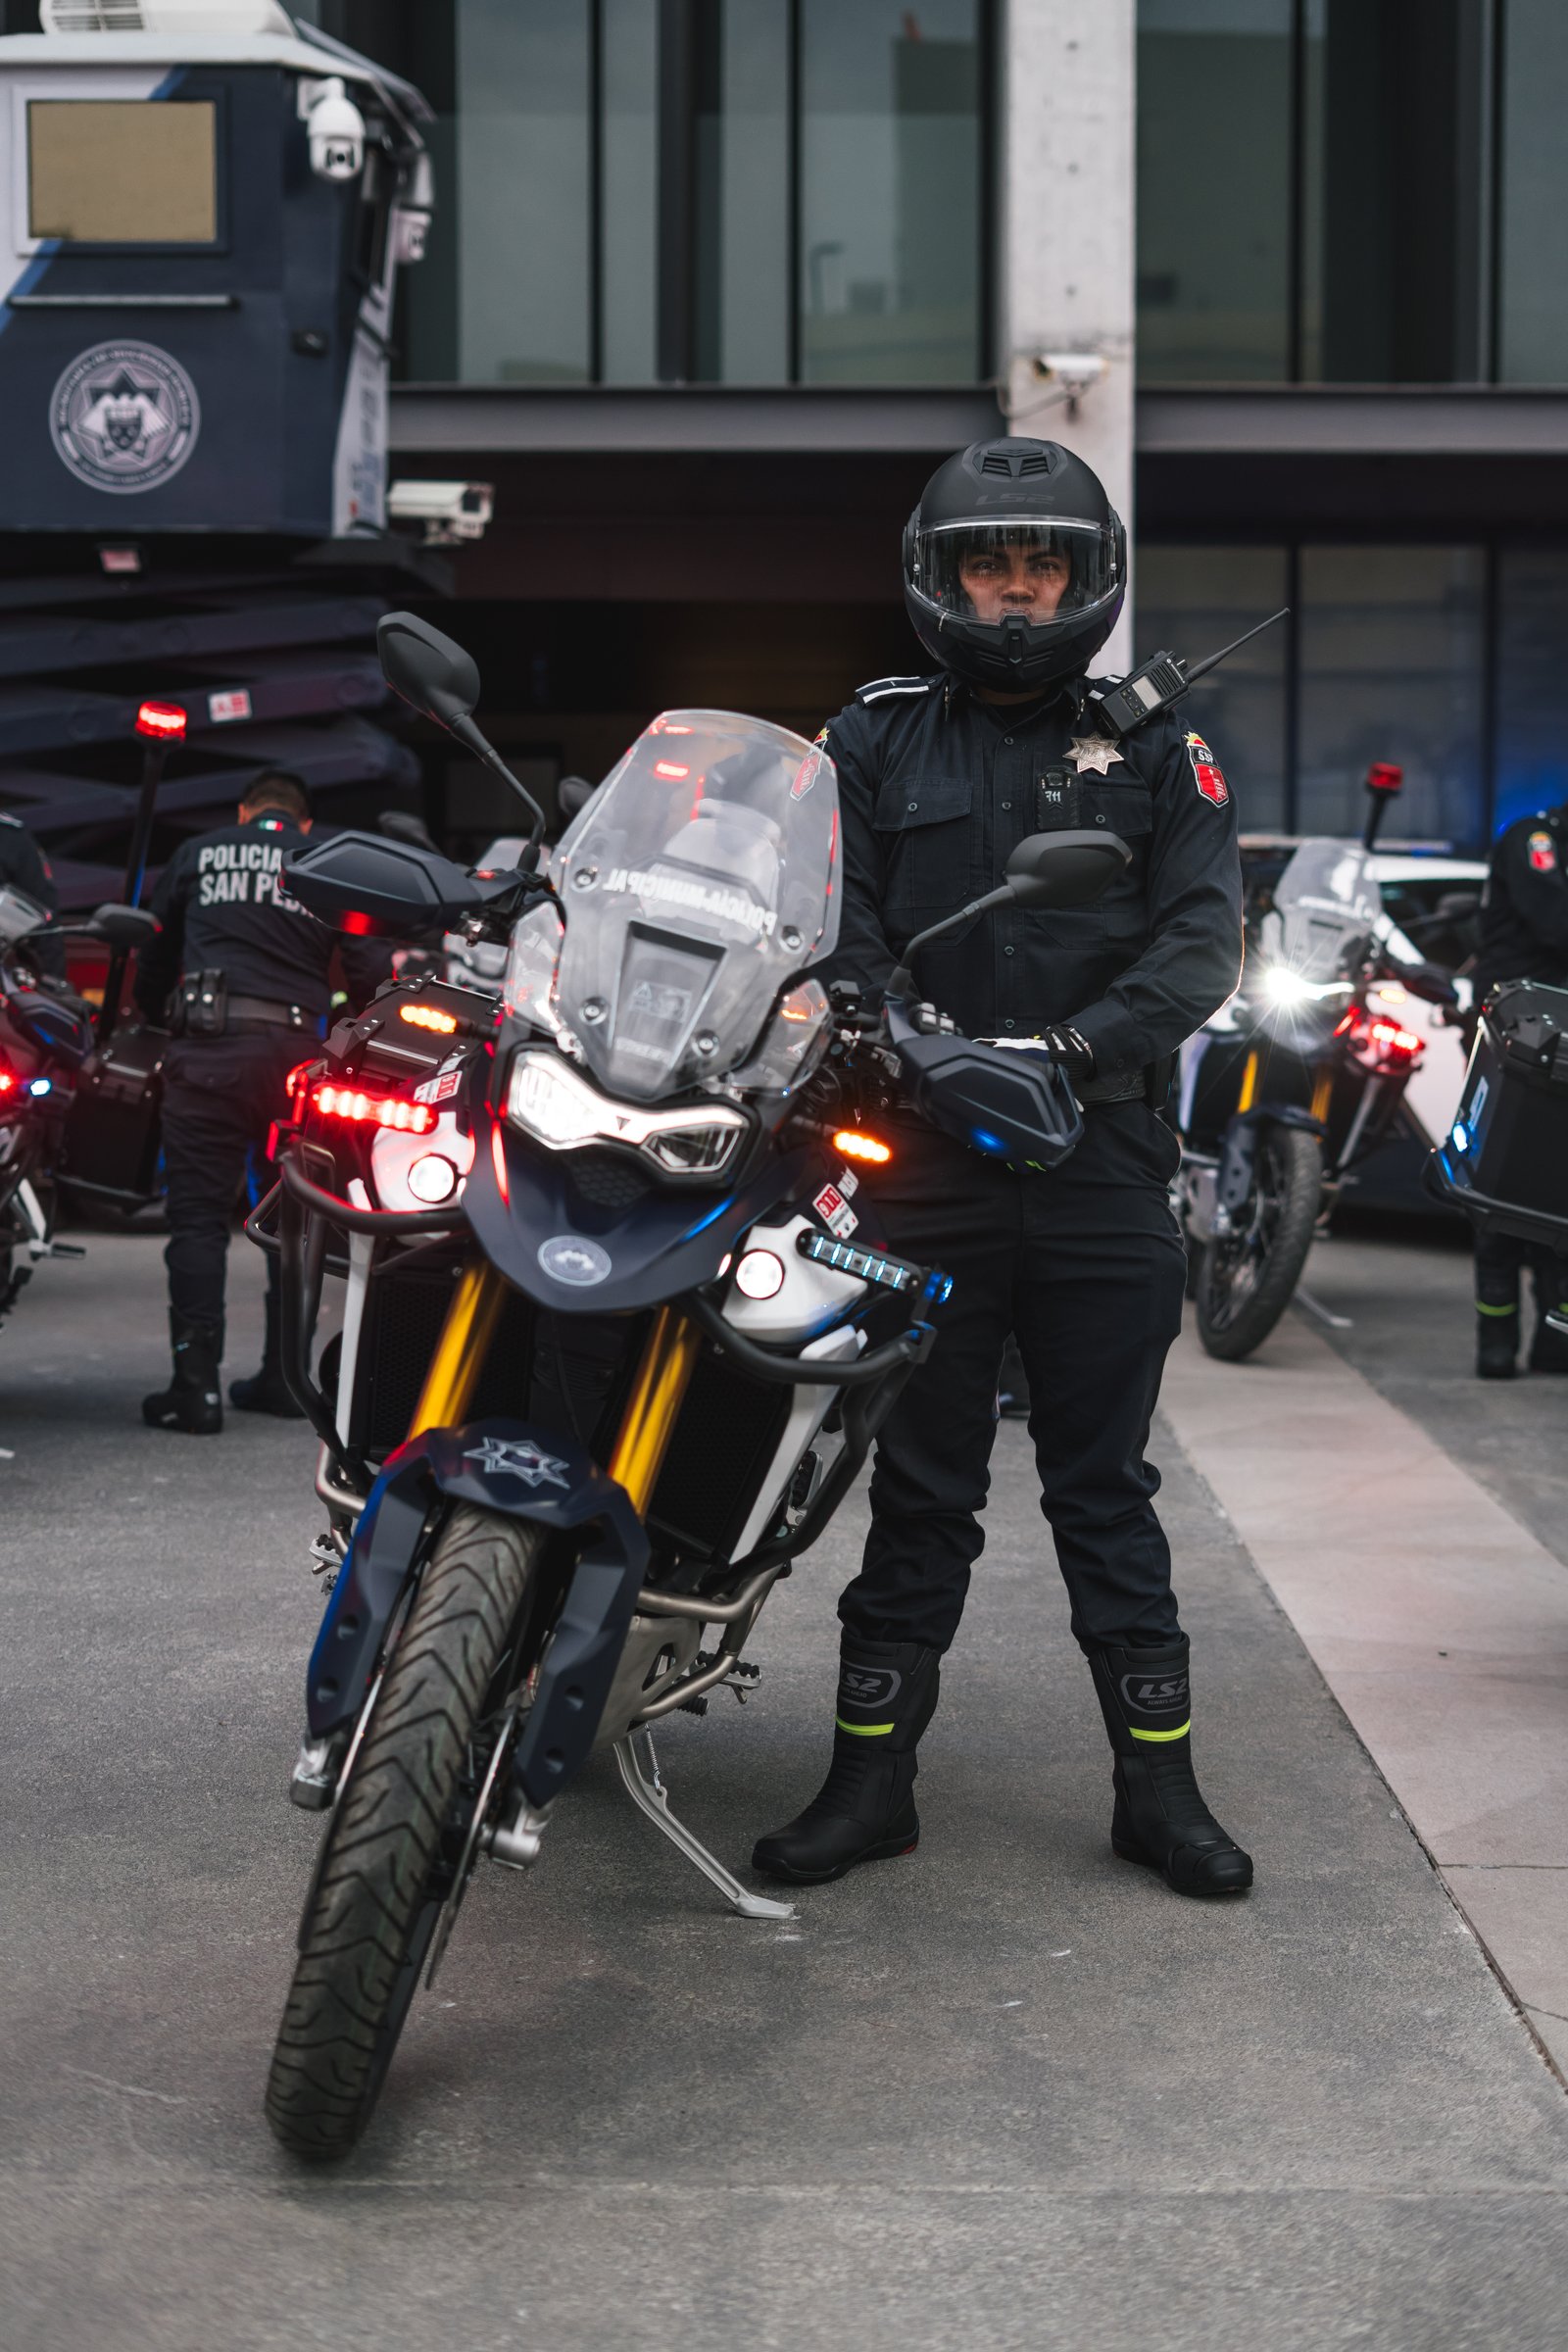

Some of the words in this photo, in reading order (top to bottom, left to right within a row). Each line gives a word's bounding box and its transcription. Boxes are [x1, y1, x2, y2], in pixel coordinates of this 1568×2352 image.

[975, 493, 1054, 506] LS2
[1045, 790, 1061, 803] 711
[199, 870, 249, 906] SAN
[818, 1189, 841, 1217] 911
[843, 1672, 882, 1693] S2
[1138, 1677, 1187, 1698] LS2
